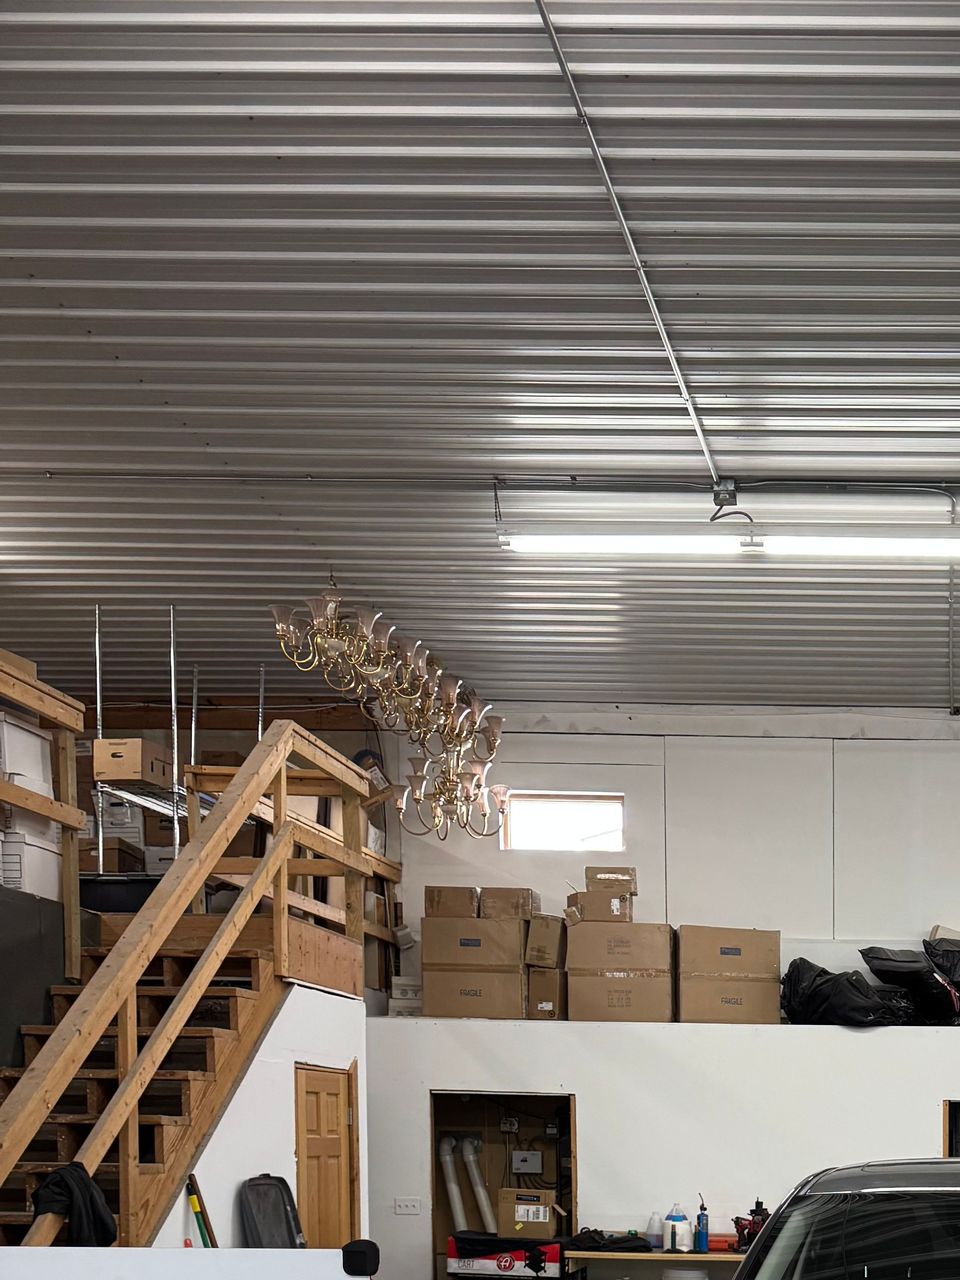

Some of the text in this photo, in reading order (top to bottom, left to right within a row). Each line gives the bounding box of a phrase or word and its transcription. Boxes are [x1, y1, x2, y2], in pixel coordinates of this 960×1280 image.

[460, 989, 482, 997] FRAGILE
[721, 997, 744, 1006] FRAGILE
[458, 1260, 475, 1269] CART
